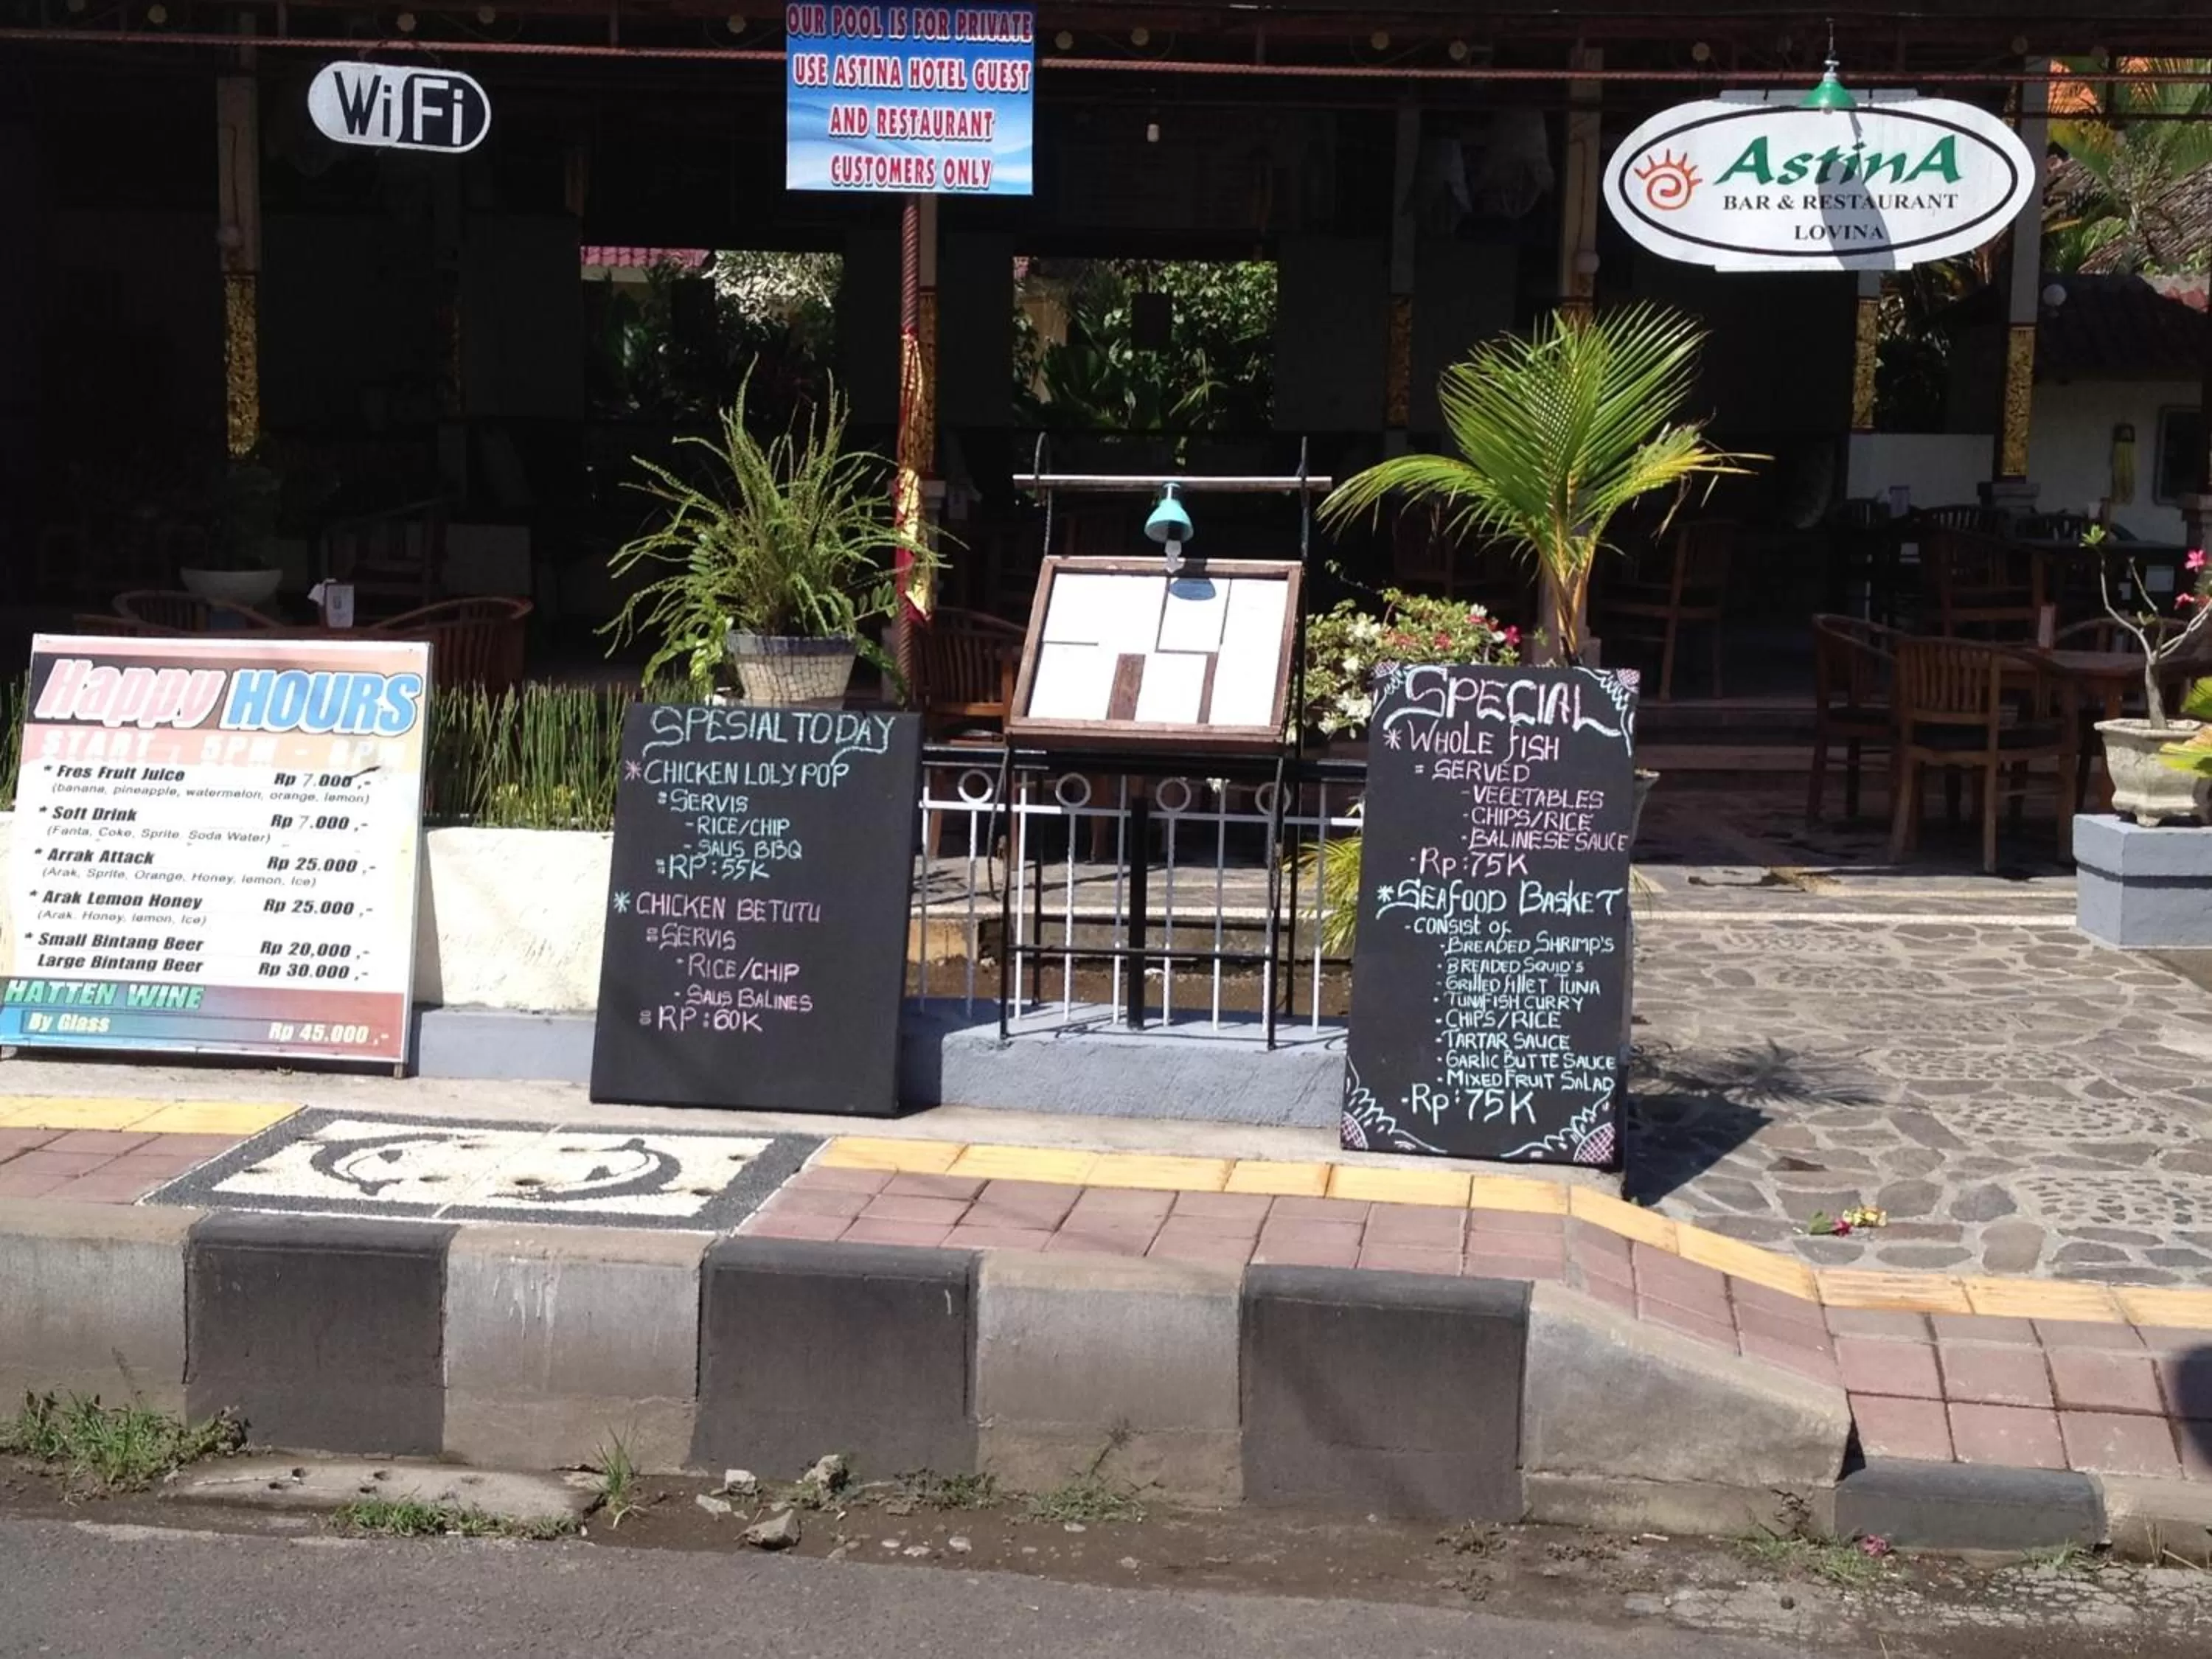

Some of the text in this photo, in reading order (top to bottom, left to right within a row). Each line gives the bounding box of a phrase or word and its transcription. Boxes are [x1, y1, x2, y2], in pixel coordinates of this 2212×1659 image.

[787, 6, 1032, 42] OUR POOL IS FOR PRIVATE
[793, 55, 1031, 91] USE ASTINA HOTEL GUEST
[334, 71, 464, 145] WiFi
[829, 106, 994, 140] AND RESTAURANT
[830, 155, 992, 189] CUSTOMERS ONLY
[1723, 194, 1959, 210] BAR & RESTAURANT
[1795, 224, 1884, 240] LOVINA
[34, 658, 423, 737] Happy HOURS
[1383, 666, 1621, 737] SPECIAL
[42, 730, 156, 762] START
[642, 706, 896, 765] SPESIAL TODAY
[1408, 720, 1494, 754] WHOLE
[97, 765, 137, 780] Fruit
[141, 767, 186, 782] Juice
[274, 772, 297, 787] Rp
[644, 759, 849, 787] CHICKEN LOLY POP
[1432, 759, 1530, 783] SERVED
[670, 788, 749, 813] SERVIS
[1474, 785, 1604, 809] VEGETABLES
[52, 805, 88, 820] Soft
[91, 807, 138, 821] Drink
[271, 814, 293, 829] Rp
[188, 830, 221, 841] Soda
[1469, 826, 1629, 851] BALINESE SAUCE
[47, 848, 94, 863] Arrak
[99, 849, 155, 865] Attack
[267, 856, 290, 871] Rp
[698, 839, 802, 860] SAUS BBQ
[42, 890, 82, 905] Arak
[86, 891, 144, 906] Lemon
[148, 894, 203, 909] Honey
[263, 898, 286, 914] Rp
[636, 892, 820, 922] CHICKEN BETUTU
[38, 932, 87, 947] Small
[91, 933, 159, 950] Bintang
[163, 936, 204, 952] Beer
[260, 941, 282, 956] Rp
[659, 923, 737, 950] SERVIS
[1444, 936, 1531, 956] BREADED
[38, 953, 86, 969] Large
[90, 955, 158, 972] Bintang
[162, 957, 204, 973] Beer
[259, 962, 281, 978] Rp
[1447, 959, 1520, 974] BREADED
[4, 979, 205, 1009] HATTEN WINE
[1554, 973, 1601, 995] TUNA
[686, 984, 813, 1012] SAUS BALINES
[1524, 995, 1584, 1012] CURRY
[28, 1012, 53, 1032] By
[58, 1013, 111, 1032] Glass
[268, 1022, 295, 1042] Rp
[1441, 1028, 1571, 1050] TARTAR SAUCE
[1563, 1053, 1616, 1069] SAUCE
[1447, 1069, 1615, 1092] MIXED FRUIT SALAD
